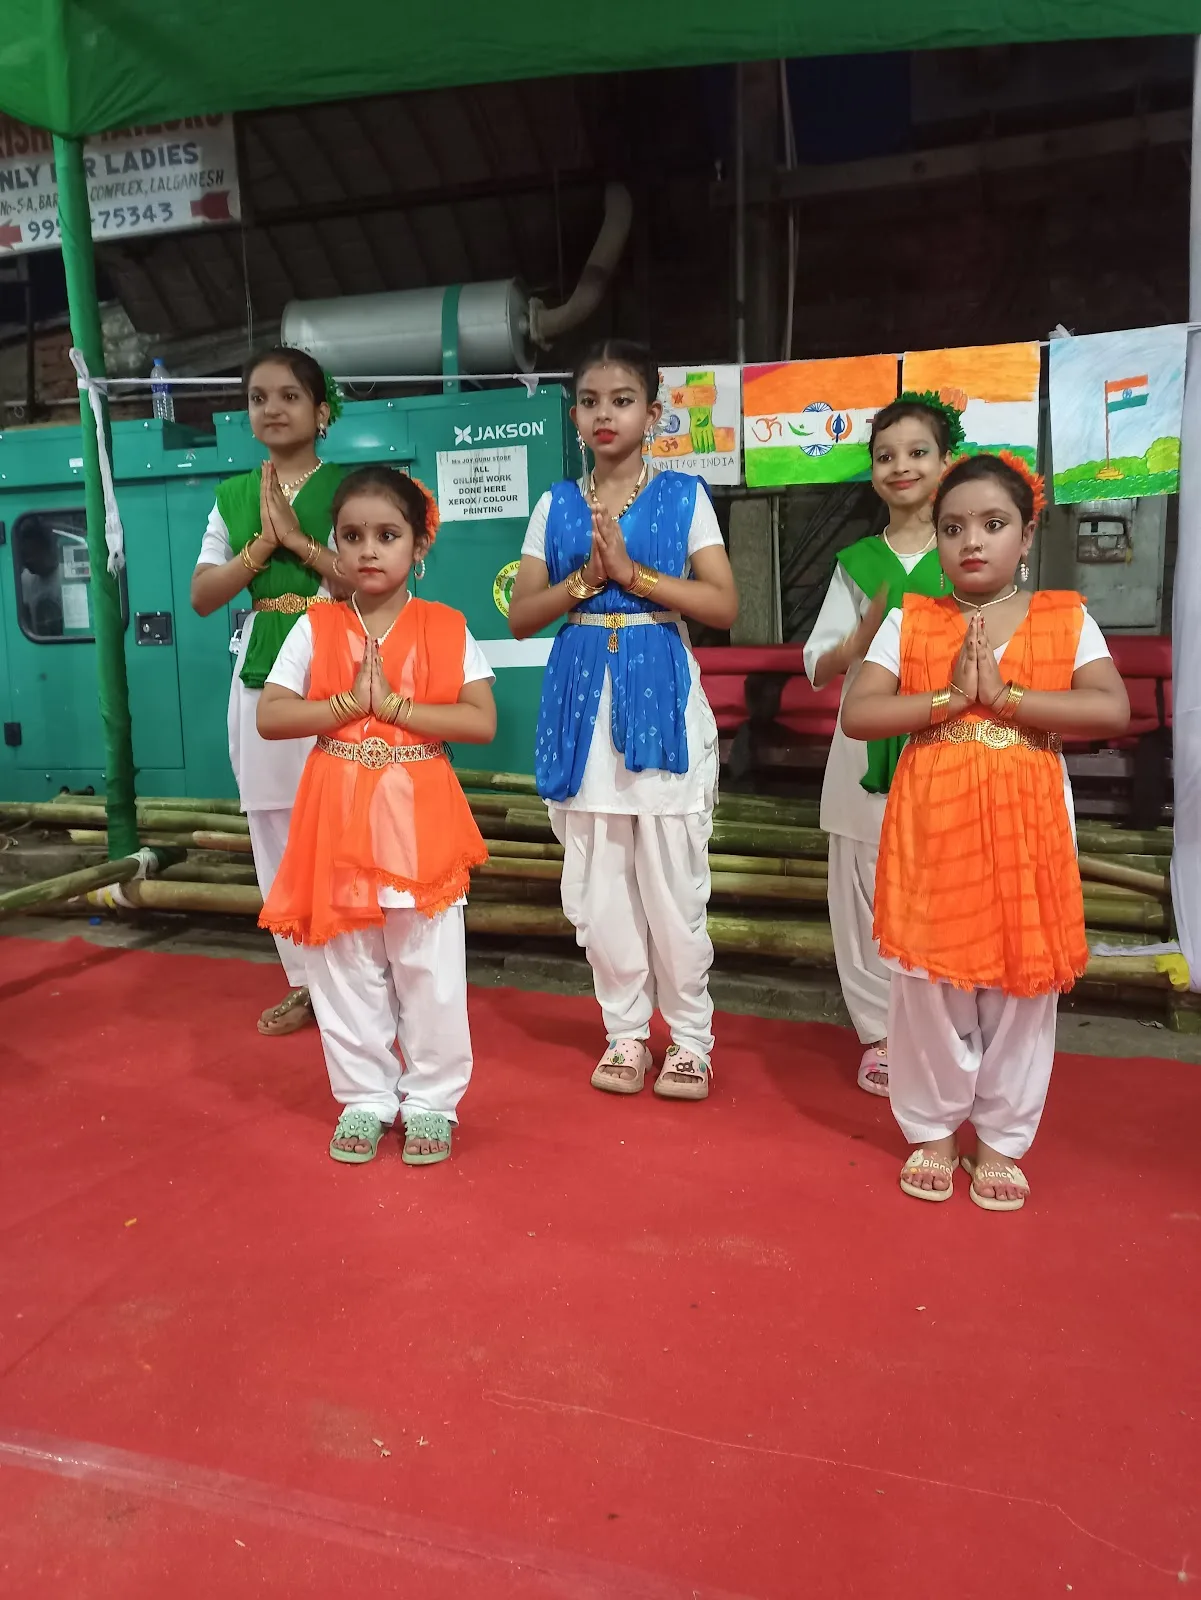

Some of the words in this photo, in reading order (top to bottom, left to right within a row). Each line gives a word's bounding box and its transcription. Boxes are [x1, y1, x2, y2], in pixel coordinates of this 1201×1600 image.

[0, 164, 40, 192] NLY
[104, 141, 199, 176] LADIES
[474, 421, 544, 441] JAKSON
[700, 456, 735, 469] INDIA
[453, 476, 484, 485] ONLINE
[486, 474, 512, 483] WORK
[458, 487, 482, 495] DONE
[484, 485, 507, 493] HERE
[448, 497, 477, 506] XEROX
[483, 494, 518, 503] COLOUR
[463, 505, 504, 515] PRINTING
